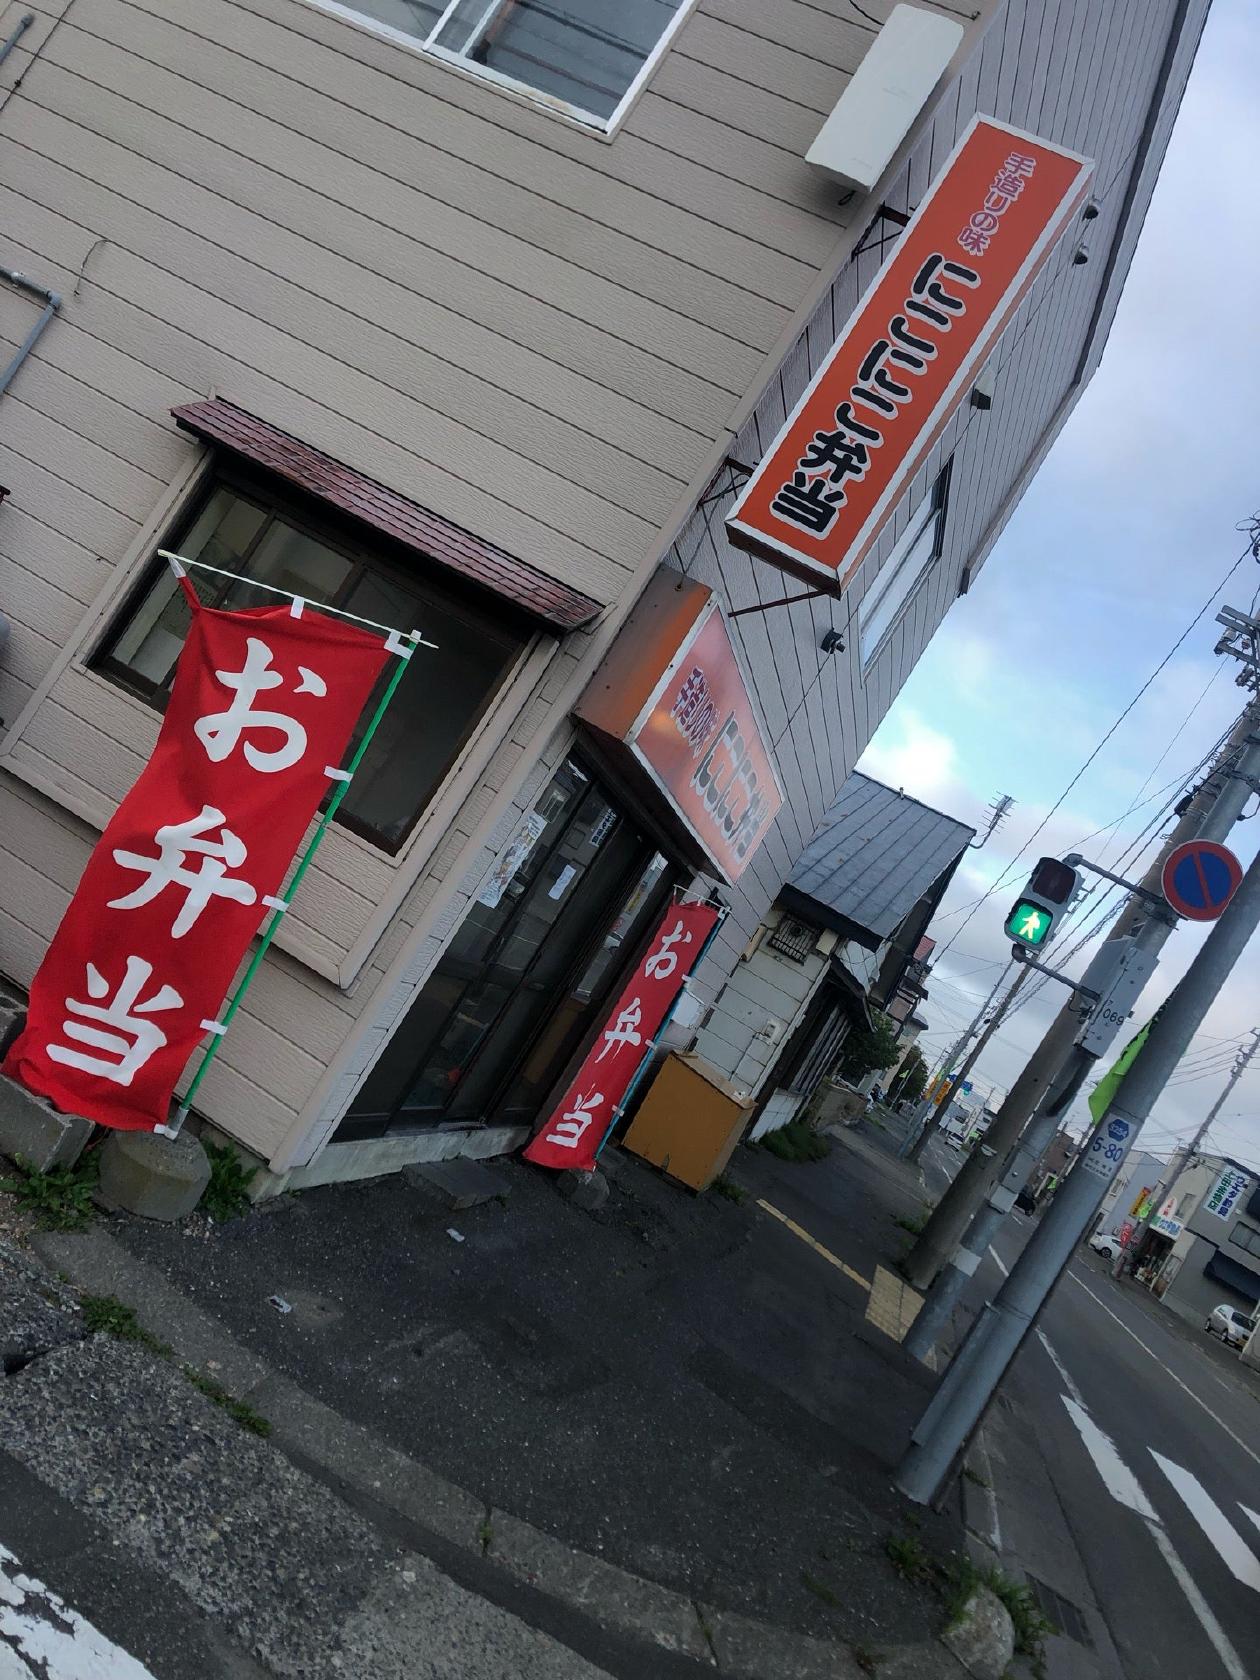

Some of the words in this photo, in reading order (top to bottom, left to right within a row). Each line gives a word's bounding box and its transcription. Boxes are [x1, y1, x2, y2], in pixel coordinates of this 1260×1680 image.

[958, 152, 1036, 256] 手造りの味
[769, 252, 981, 539] にこにこ弁当
[45, 636, 328, 1086] お弁当
[546, 920, 692, 1149] お弁当
[1102, 1008, 1125, 1026] 069
[1092, 1136, 1124, 1162] 5-80
